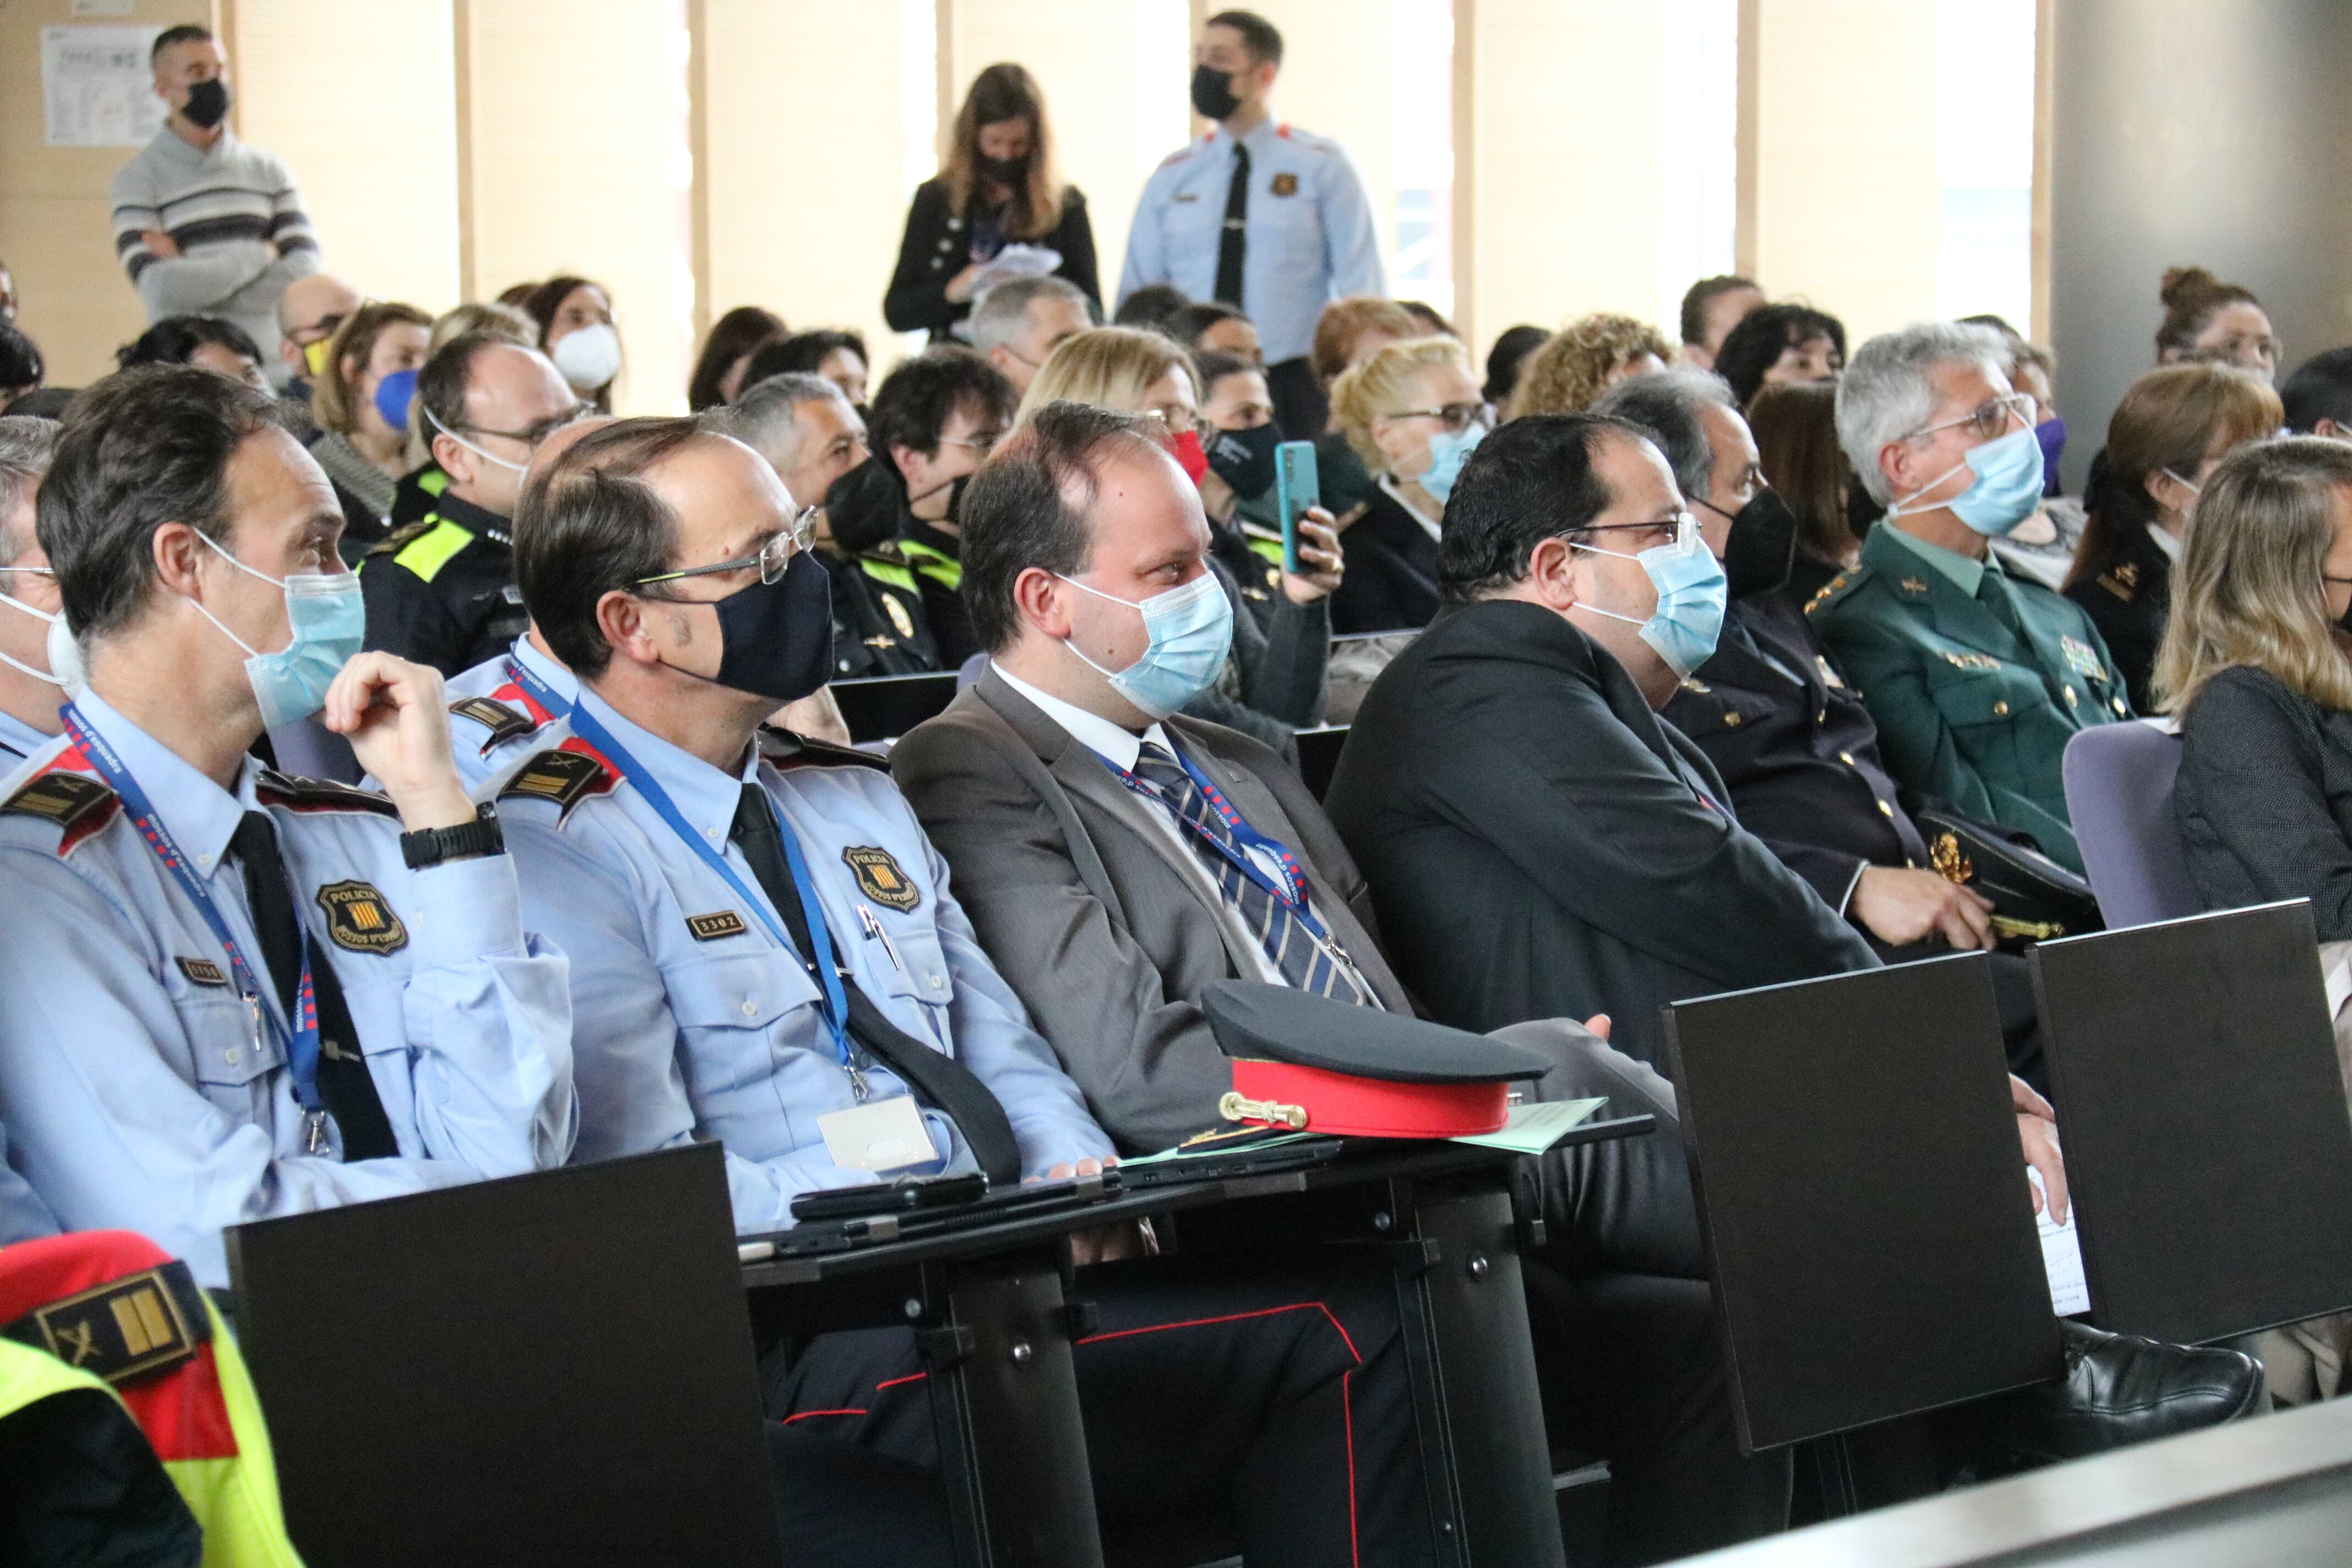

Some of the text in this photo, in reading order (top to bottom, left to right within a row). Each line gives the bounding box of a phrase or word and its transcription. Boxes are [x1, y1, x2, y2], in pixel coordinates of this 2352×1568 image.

[85, 730, 121, 774] d'esquadra
[146, 814, 205, 897] mossos d'esquadra
[853, 854, 889, 864] POLICIA
[330, 889, 378, 903] POLICIA
[1285, 872, 1299, 905] mossos
[699, 916, 737, 932] 3302
